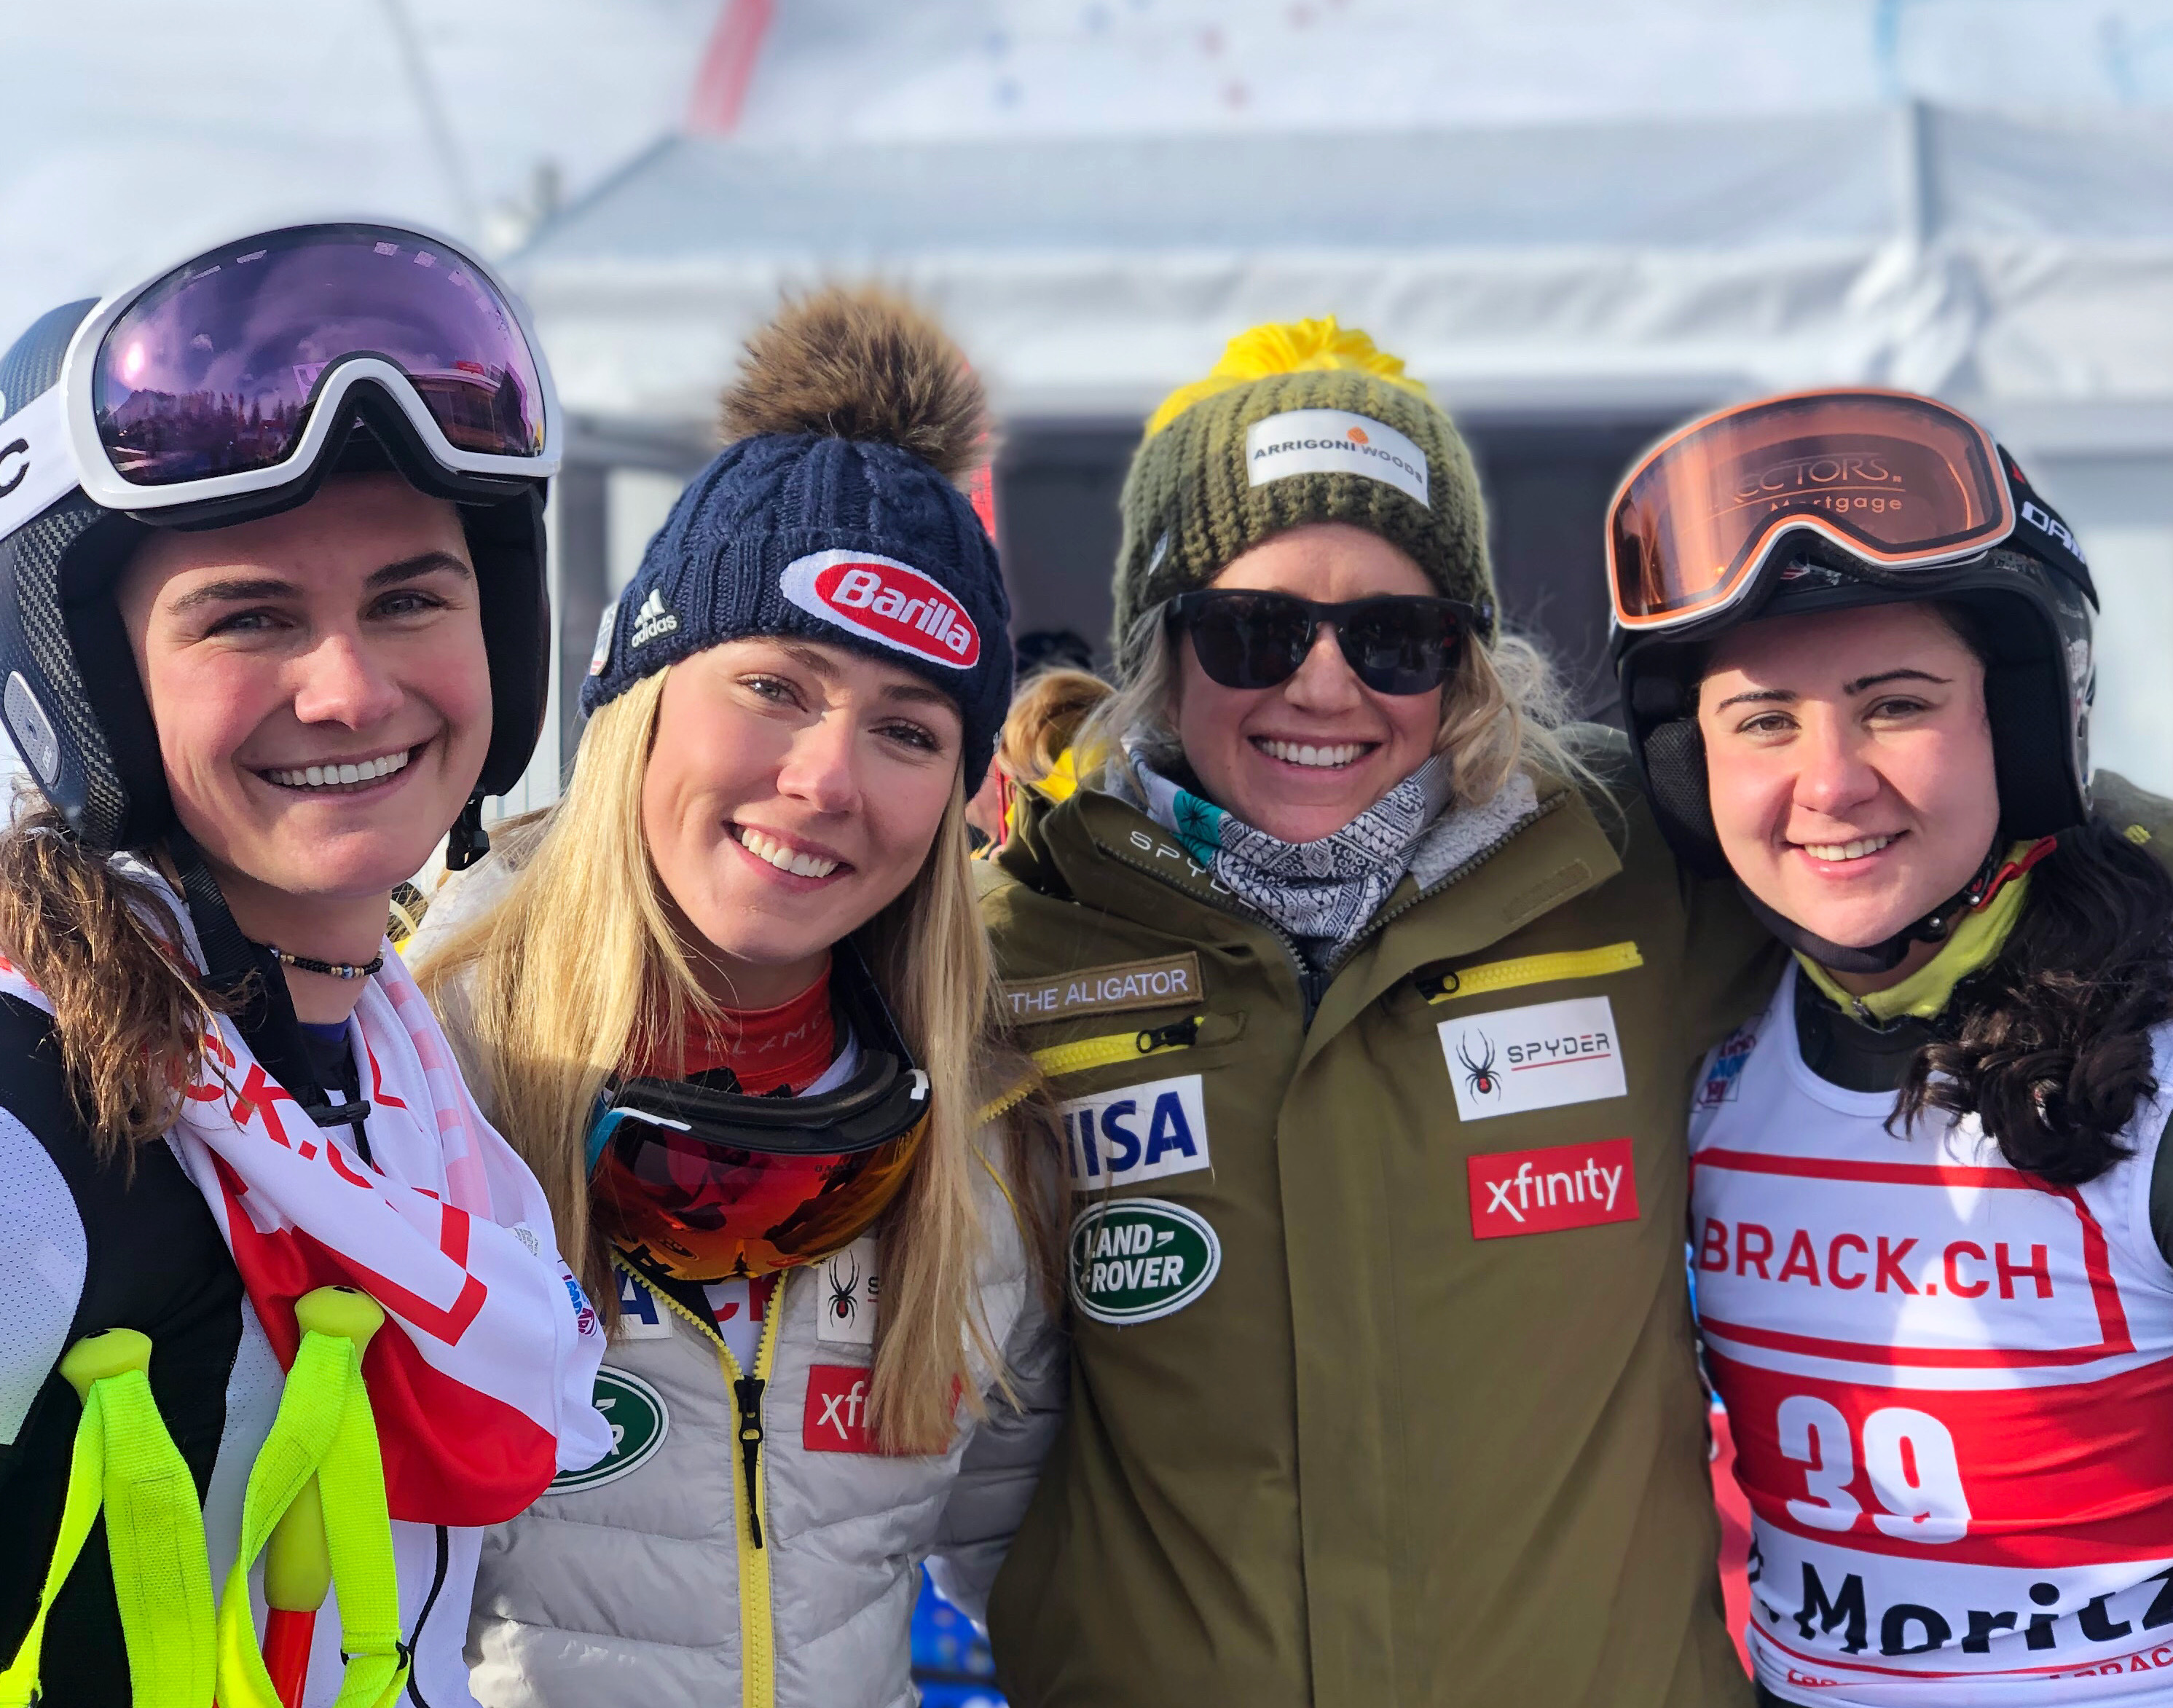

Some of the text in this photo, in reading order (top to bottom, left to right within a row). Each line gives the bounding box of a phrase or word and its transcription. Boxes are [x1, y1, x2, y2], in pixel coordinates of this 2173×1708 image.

[1254, 438, 1424, 484] ARRIGONI WOODS
[1769, 495, 1903, 513] Mrtgage
[631, 614, 677, 648] adidas
[830, 570, 971, 656] Barilla
[1007, 969, 1189, 1014] THE ALIGATOR
[1506, 1033, 1611, 1064] SPYDER
[1485, 1157, 1623, 1223] xfinity
[1084, 1223, 1152, 1259] LAND
[1699, 1216, 2054, 1300] BRACK.CH
[1091, 1255, 1184, 1293] ROVER
[1777, 1394, 1973, 1545] 39
